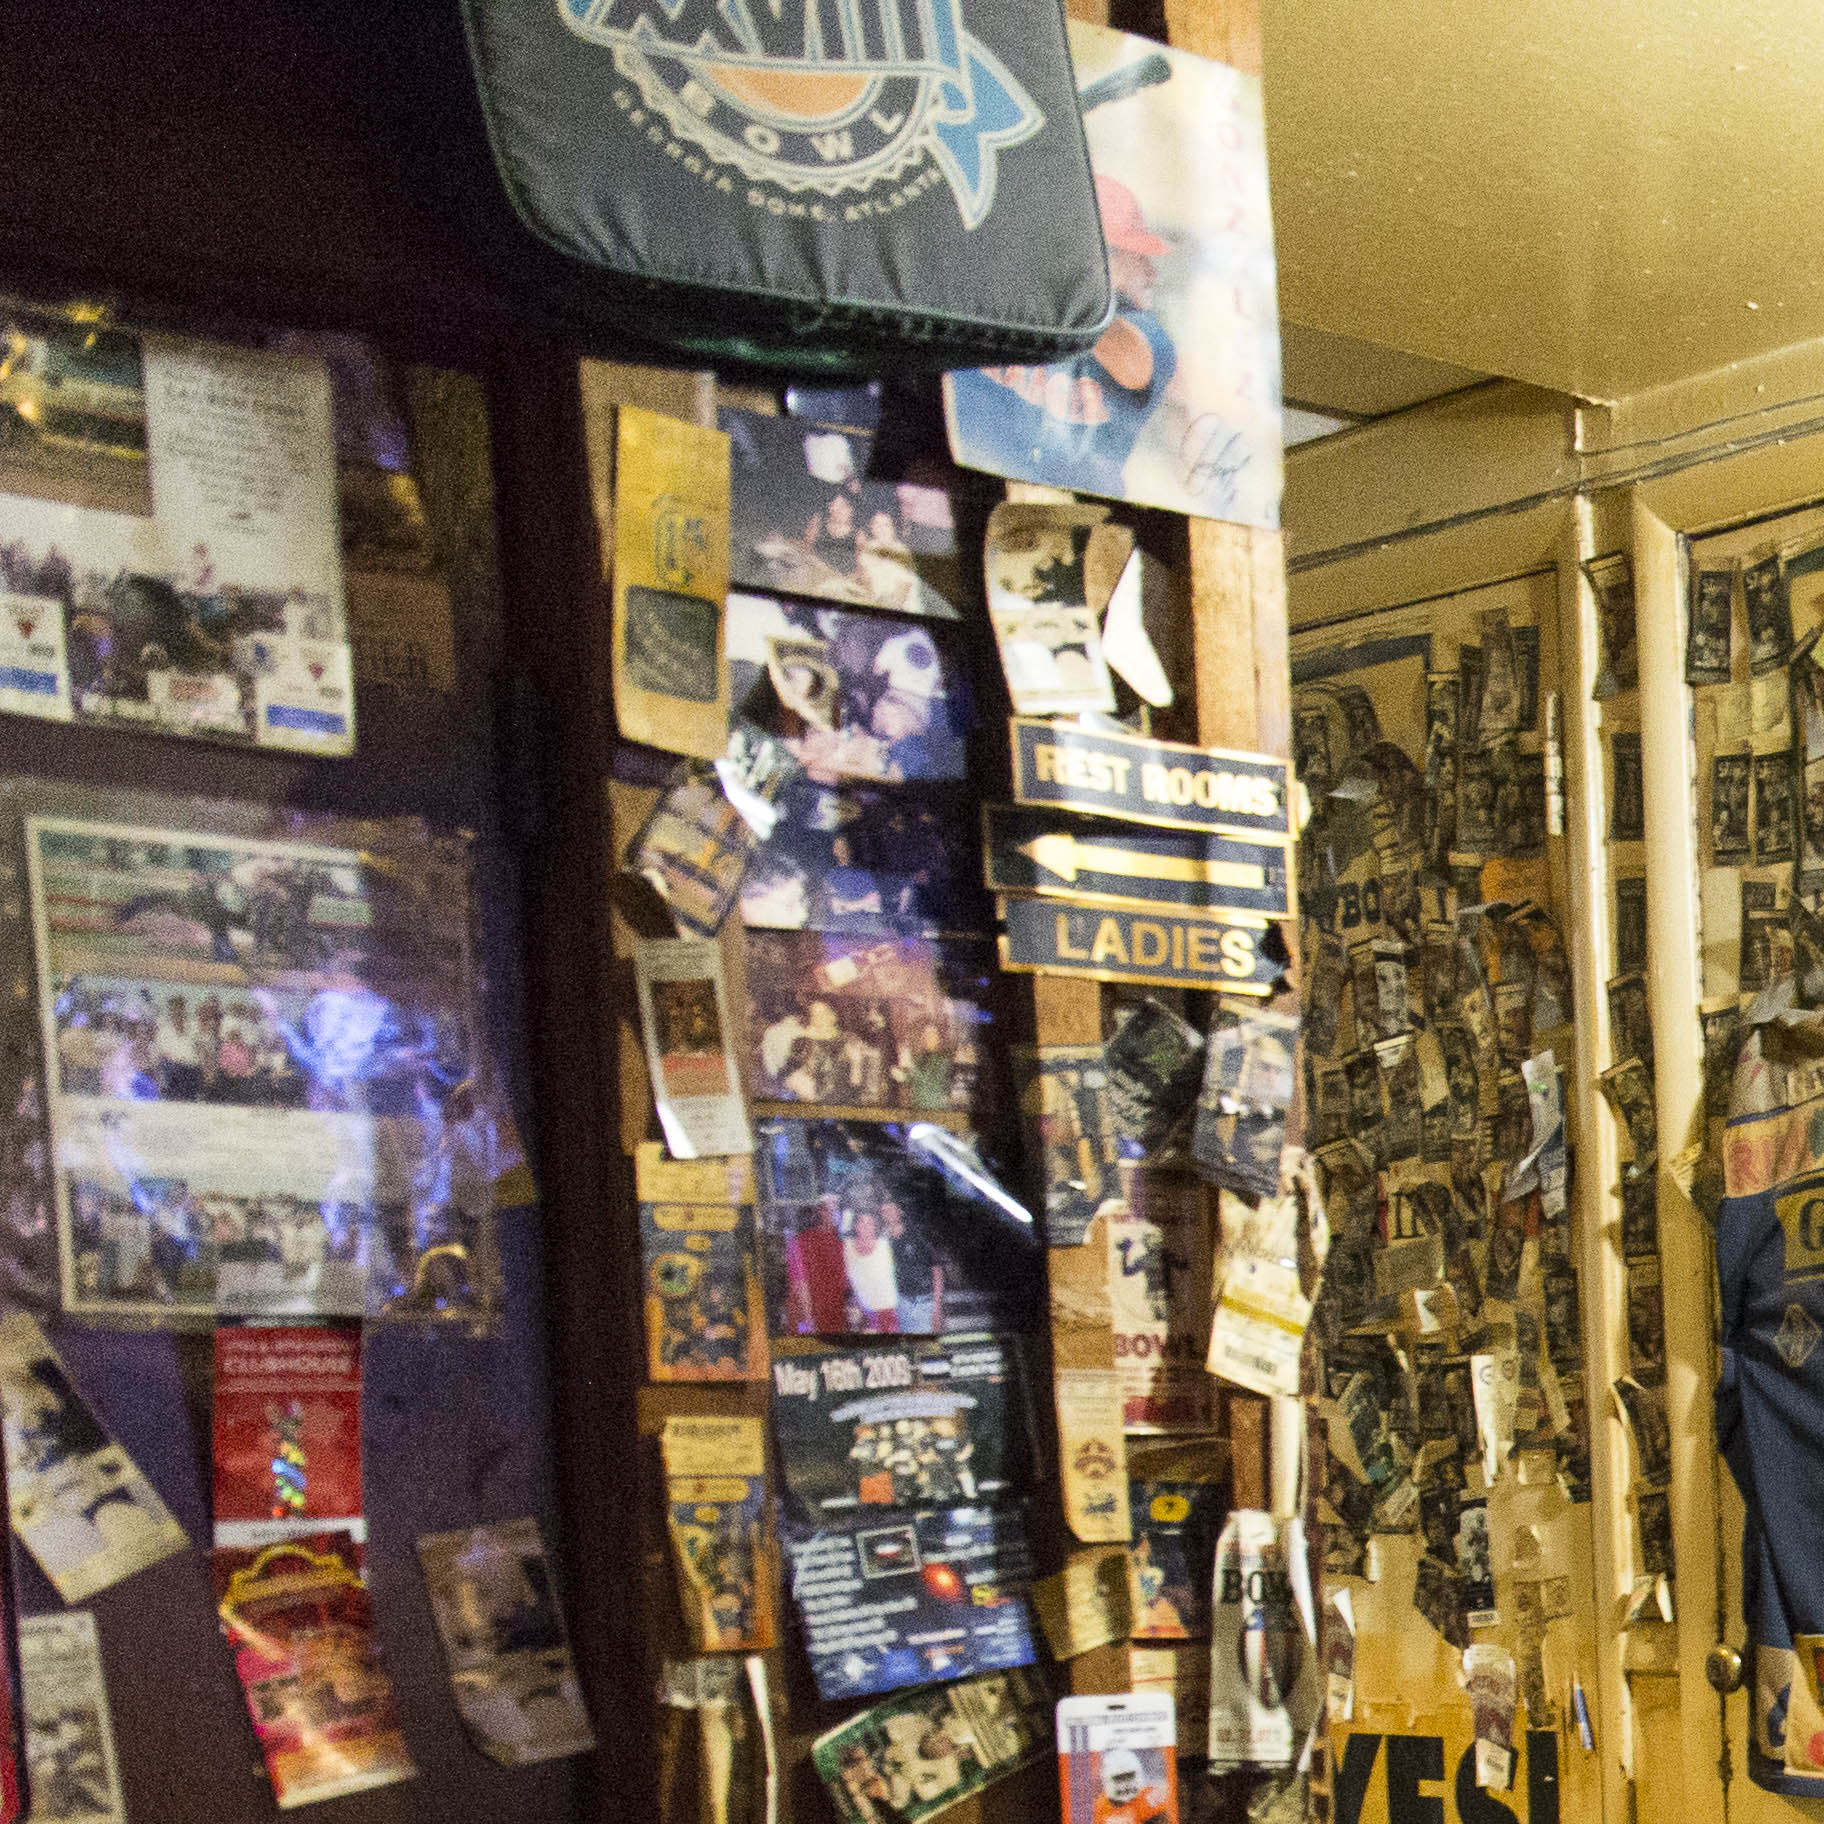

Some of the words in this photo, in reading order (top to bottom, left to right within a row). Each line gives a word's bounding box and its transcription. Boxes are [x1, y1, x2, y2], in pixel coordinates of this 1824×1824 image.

[680, 80, 904, 162] BOWL
[1034, 744, 1131, 796] REST
[1142, 760, 1281, 817] ROOMS
[1057, 912, 1258, 979] LADIES
[773, 1363, 818, 1400] May
